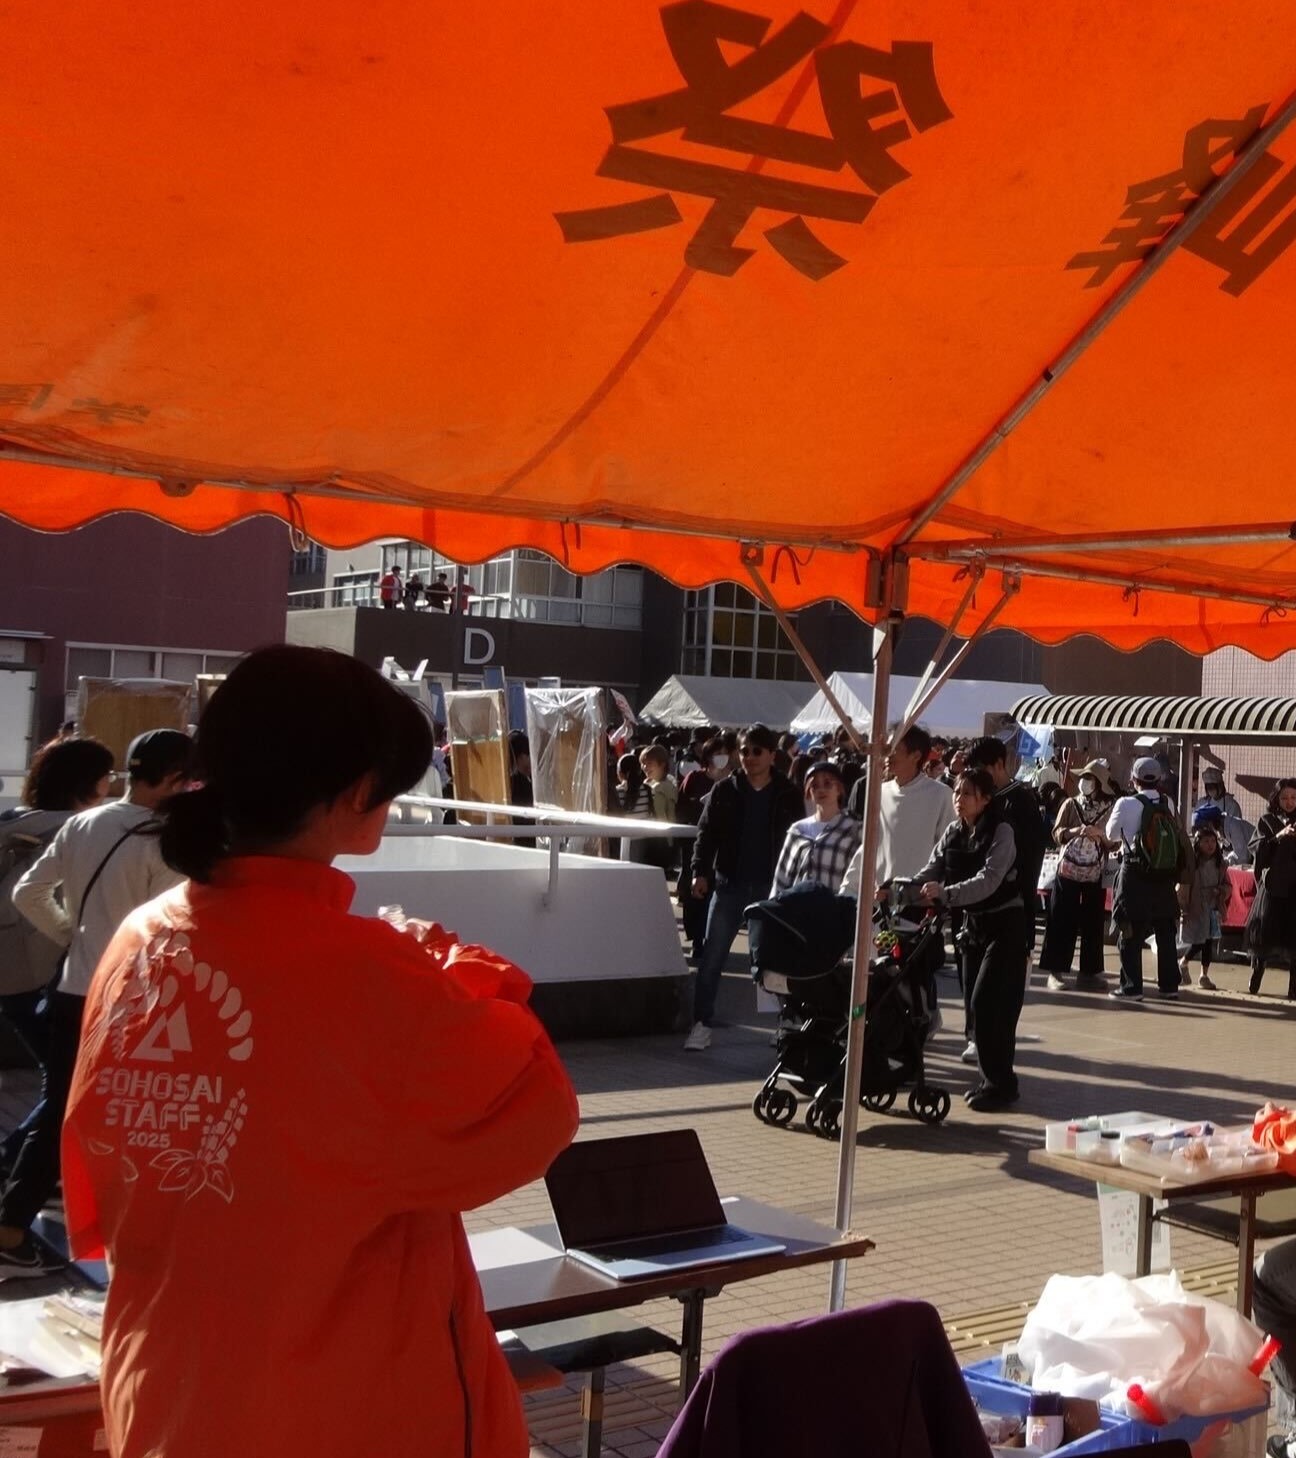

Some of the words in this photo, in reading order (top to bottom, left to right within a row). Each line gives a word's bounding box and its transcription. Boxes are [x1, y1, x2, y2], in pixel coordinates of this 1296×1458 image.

[464, 627, 495, 665] D
[96, 1067, 222, 1104] SOHOSAI
[105, 1098, 201, 1131] STAFF
[127, 1131, 171, 1148] 2025
